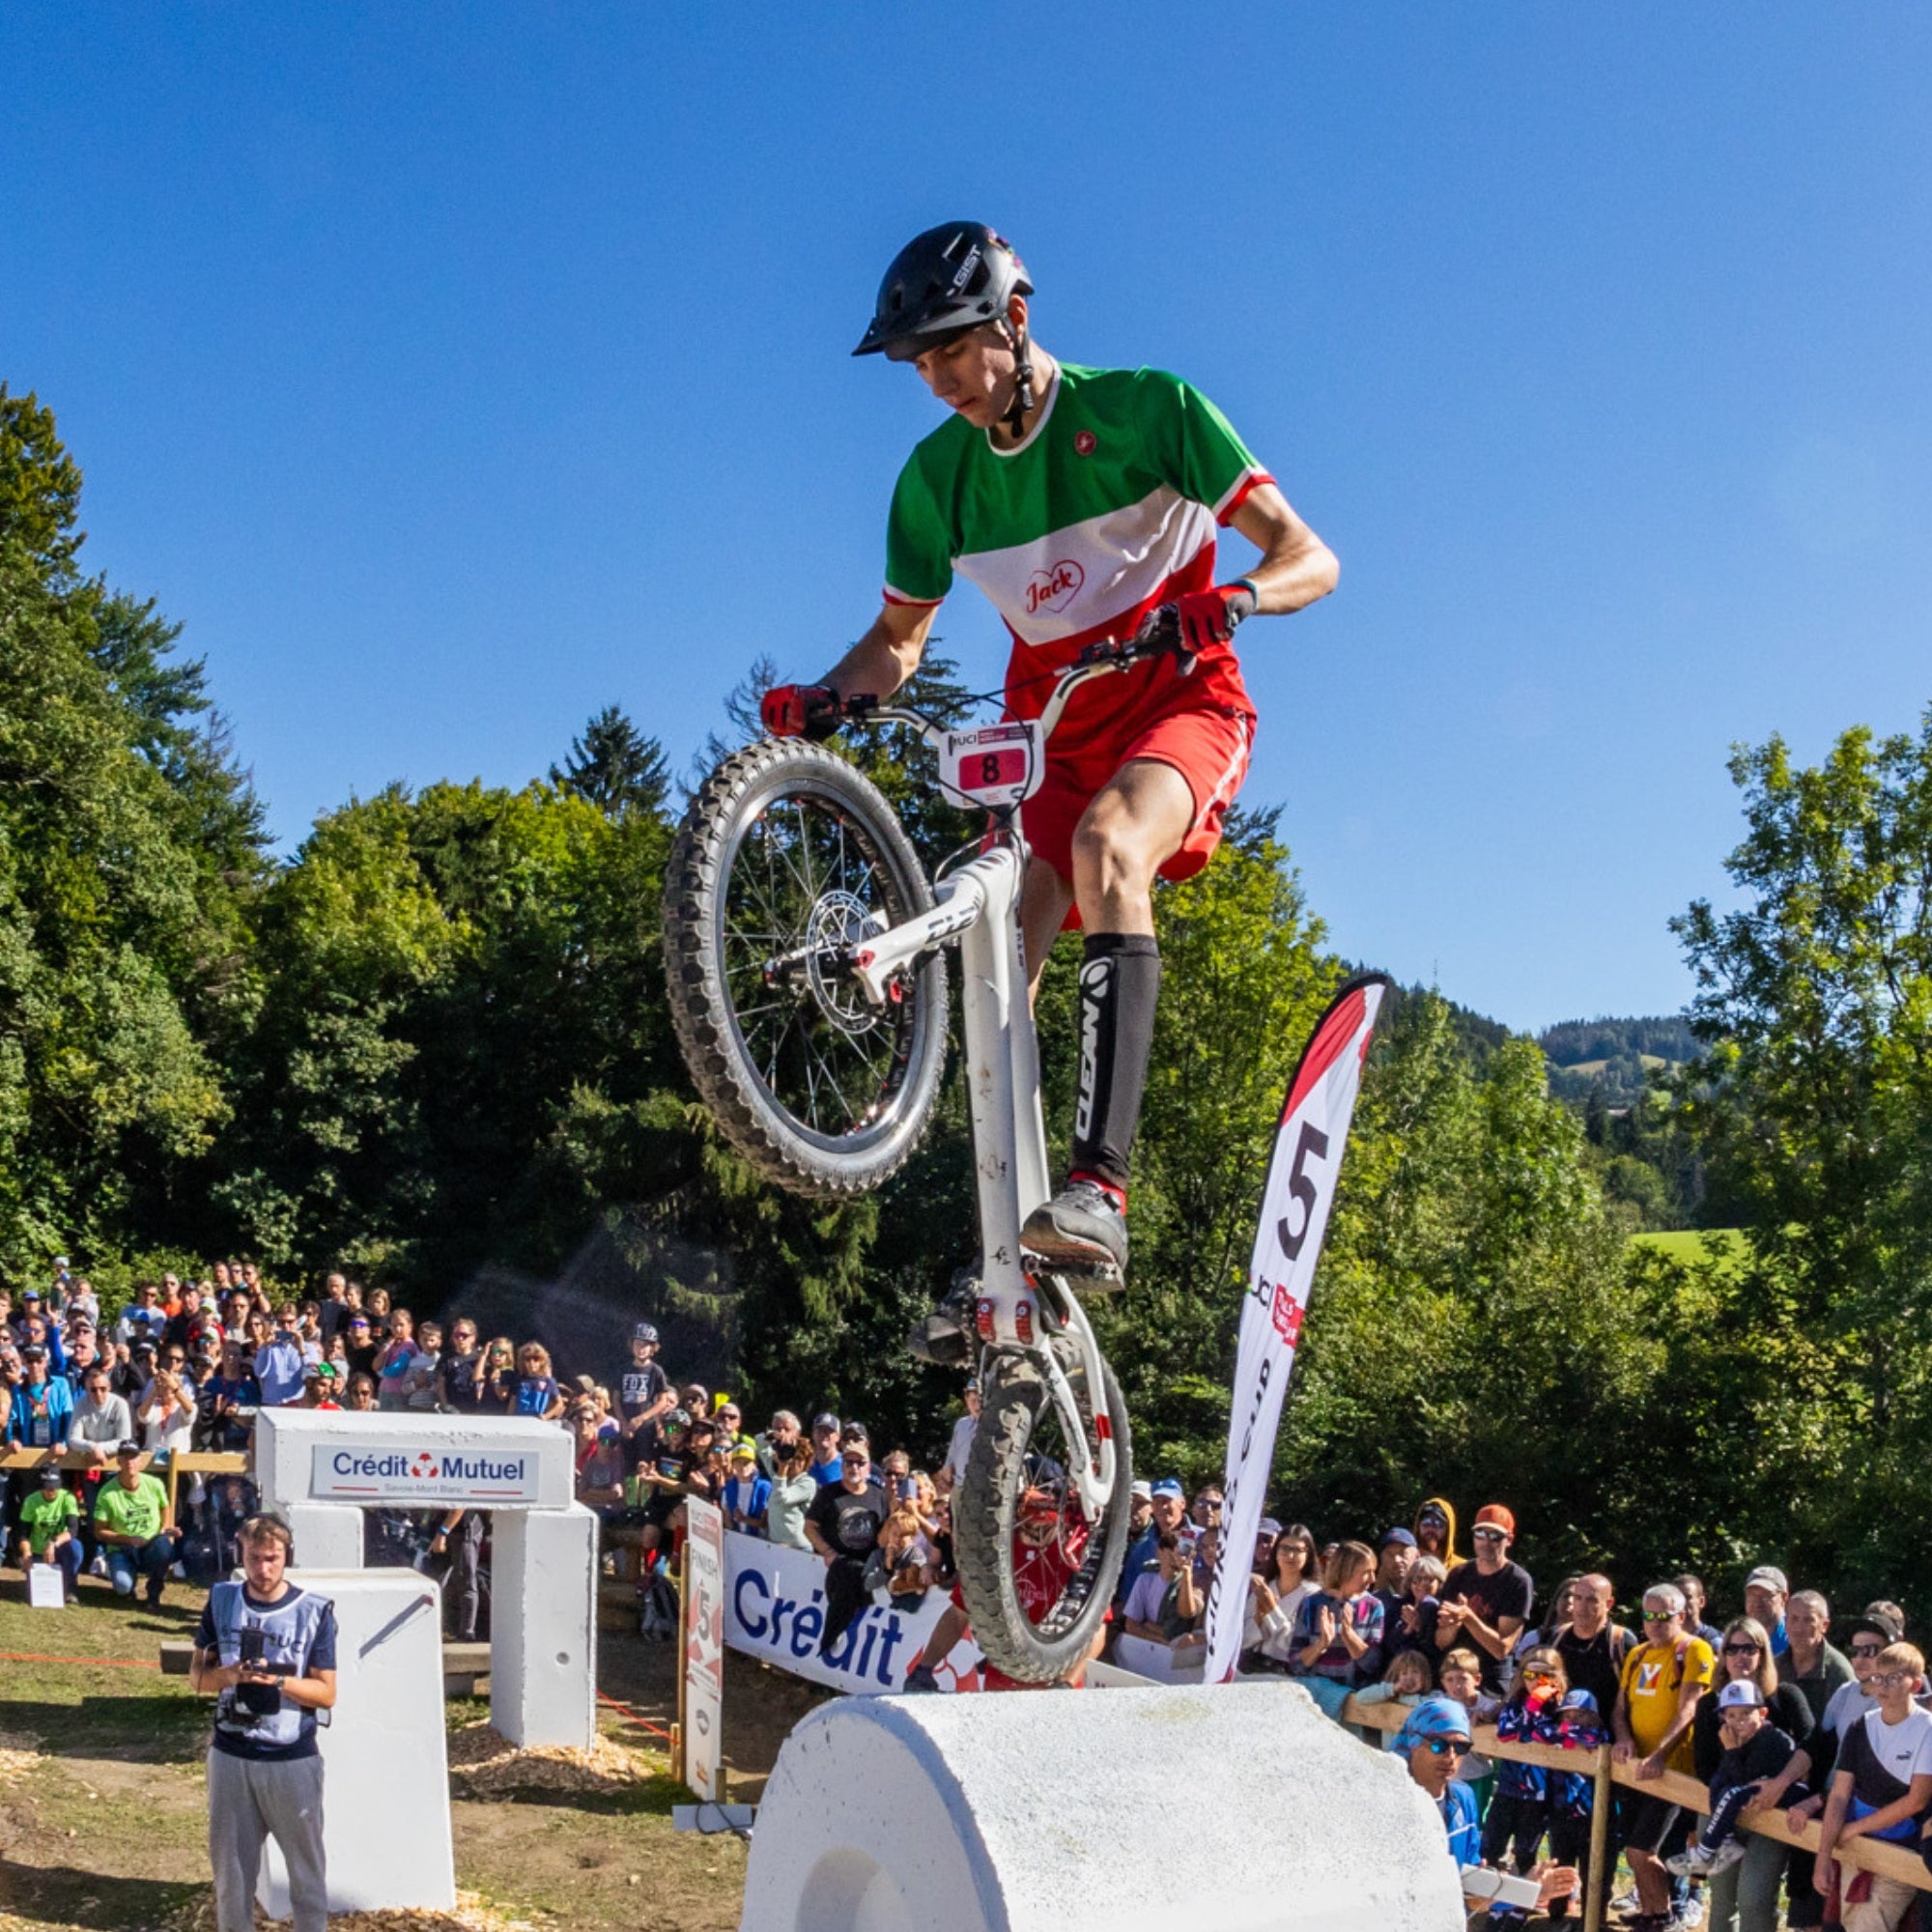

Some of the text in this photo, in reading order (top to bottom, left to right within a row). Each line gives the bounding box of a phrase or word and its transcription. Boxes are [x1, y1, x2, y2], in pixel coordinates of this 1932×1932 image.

[953, 243, 981, 287] GIST
[1026, 568, 1077, 612] Jack
[957, 734, 977, 747] UCI
[982, 754, 1000, 783] 8
[1278, 1120, 1329, 1262] 5
[622, 1374, 650, 1391] FOX
[333, 1452, 525, 1481] Crédit Mutuel
[692, 1548, 718, 1581] FINISH
[698, 1590, 710, 1641] 5
[1706, 1791, 1733, 1834] MICKEY
